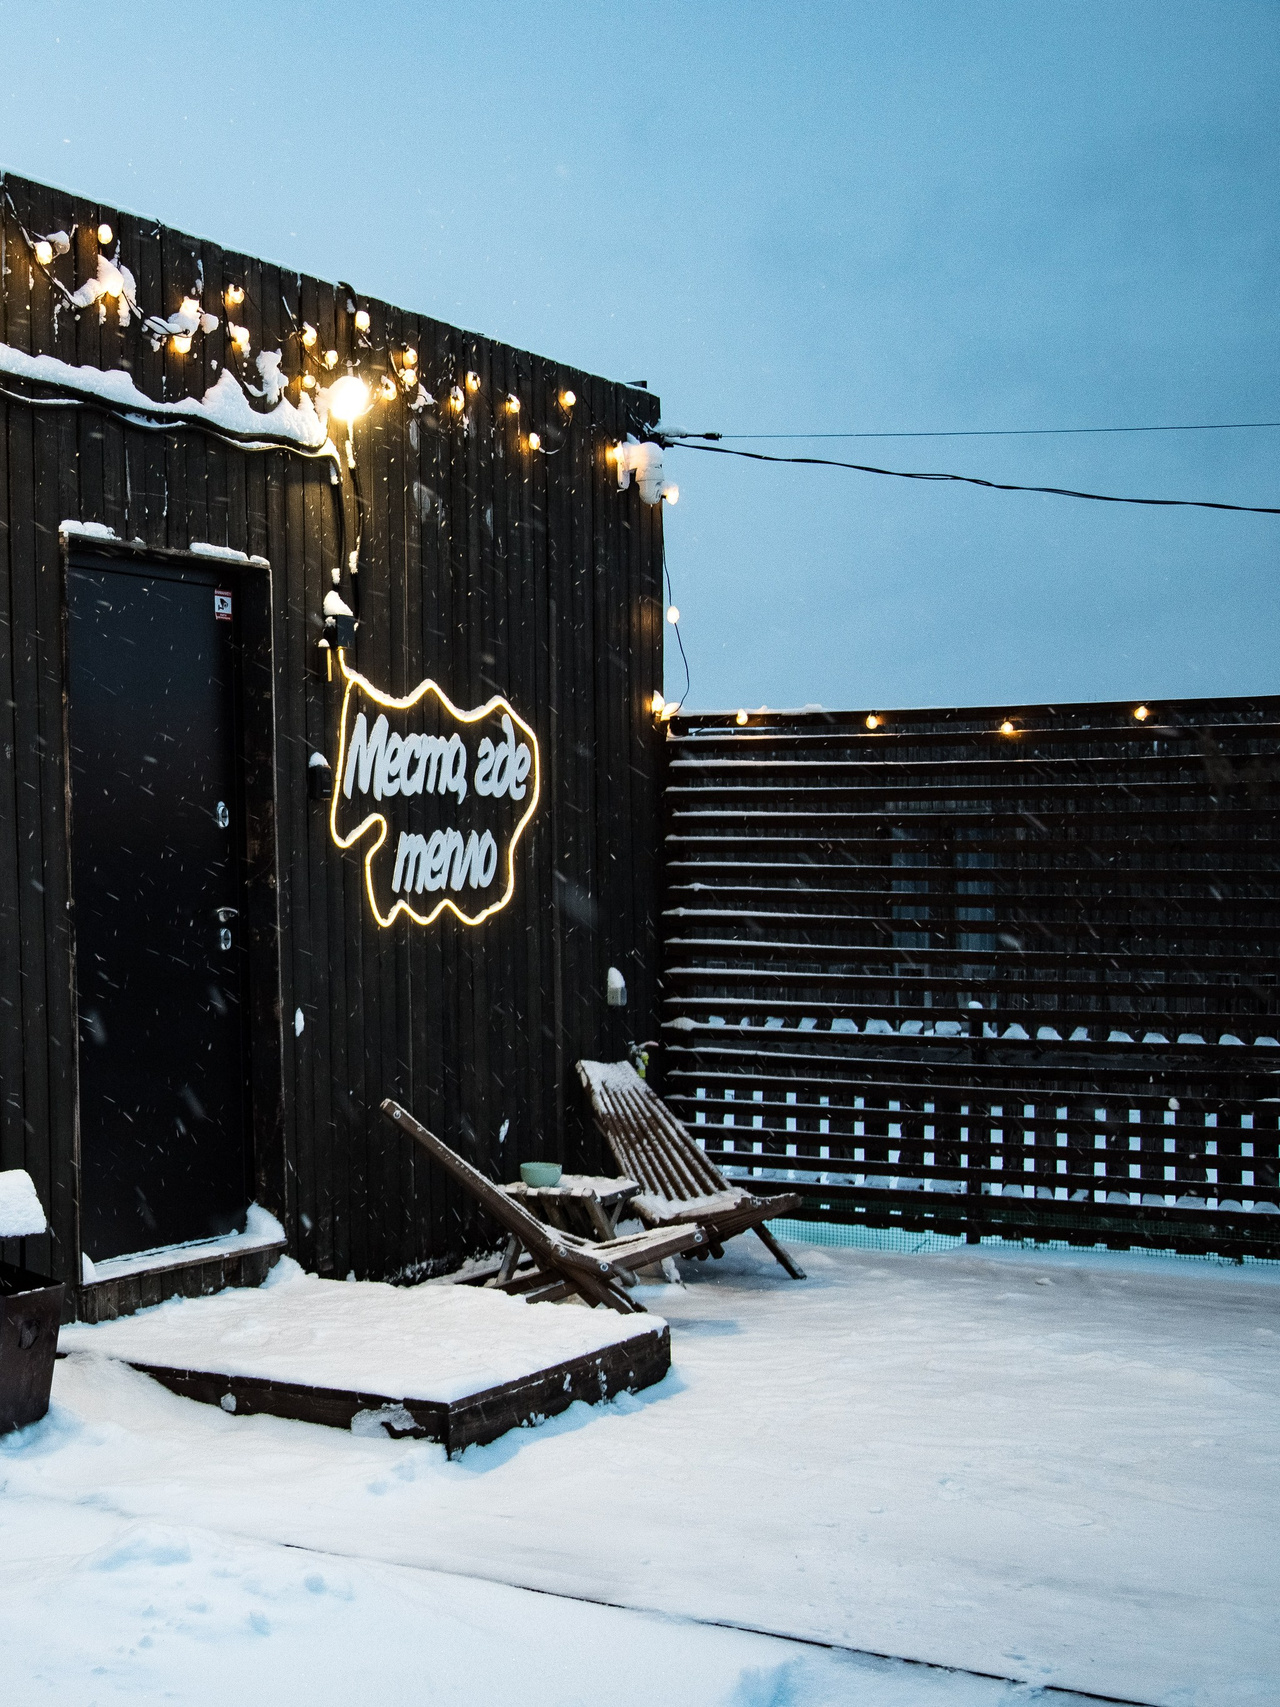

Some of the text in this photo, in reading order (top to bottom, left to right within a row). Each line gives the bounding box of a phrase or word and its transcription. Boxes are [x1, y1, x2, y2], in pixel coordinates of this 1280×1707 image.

[343, 713, 531, 804] Место, где
[391, 827, 498, 894] тепло
